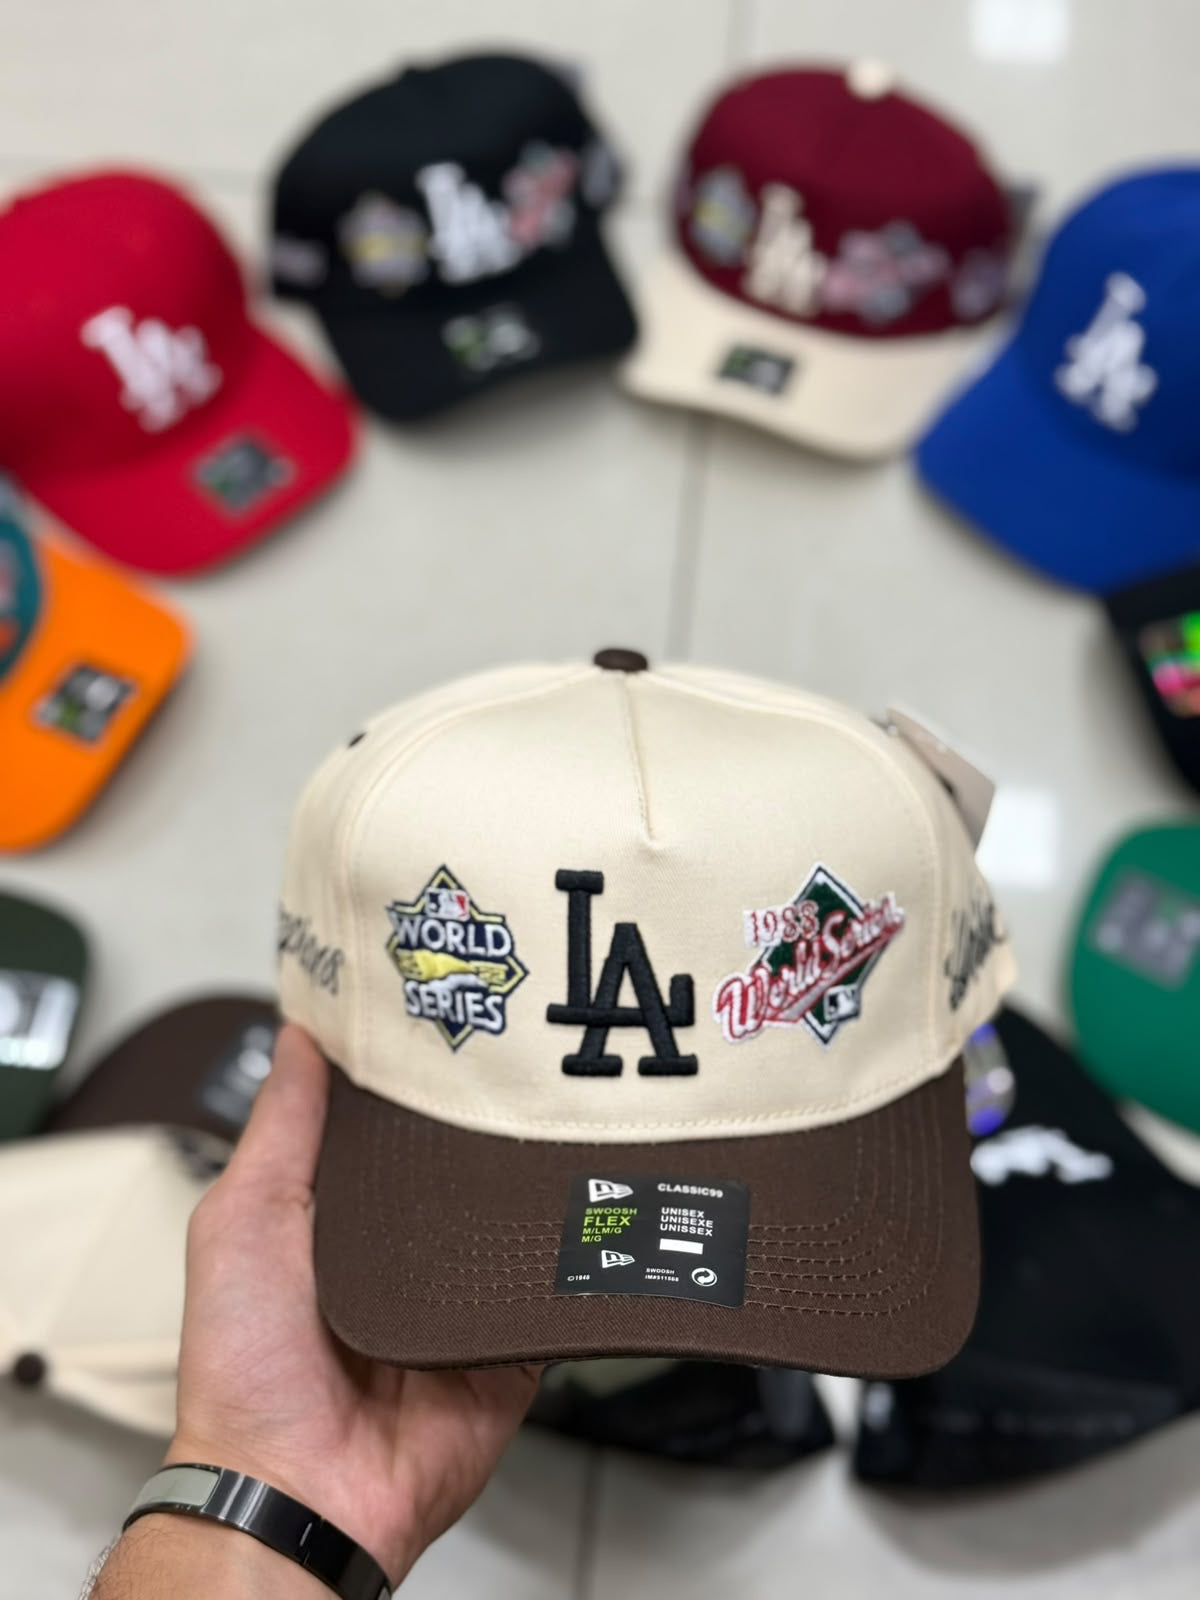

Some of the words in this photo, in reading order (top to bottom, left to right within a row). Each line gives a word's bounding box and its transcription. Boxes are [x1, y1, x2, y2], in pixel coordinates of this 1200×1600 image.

[387, 909, 512, 957] WORLD
[546, 868, 698, 1078] LA
[405, 975, 503, 1031] SERIES
[657, 1183, 724, 1198] CLASSIC99
[585, 1207, 638, 1216] SWOOSH
[661, 1206, 705, 1218] UNISEX
[583, 1216, 632, 1226] FLEX
[660, 1214, 713, 1228] UNISEXE
[659, 1223, 713, 1237] UNISSEX
[581, 1235, 602, 1243] M/G
